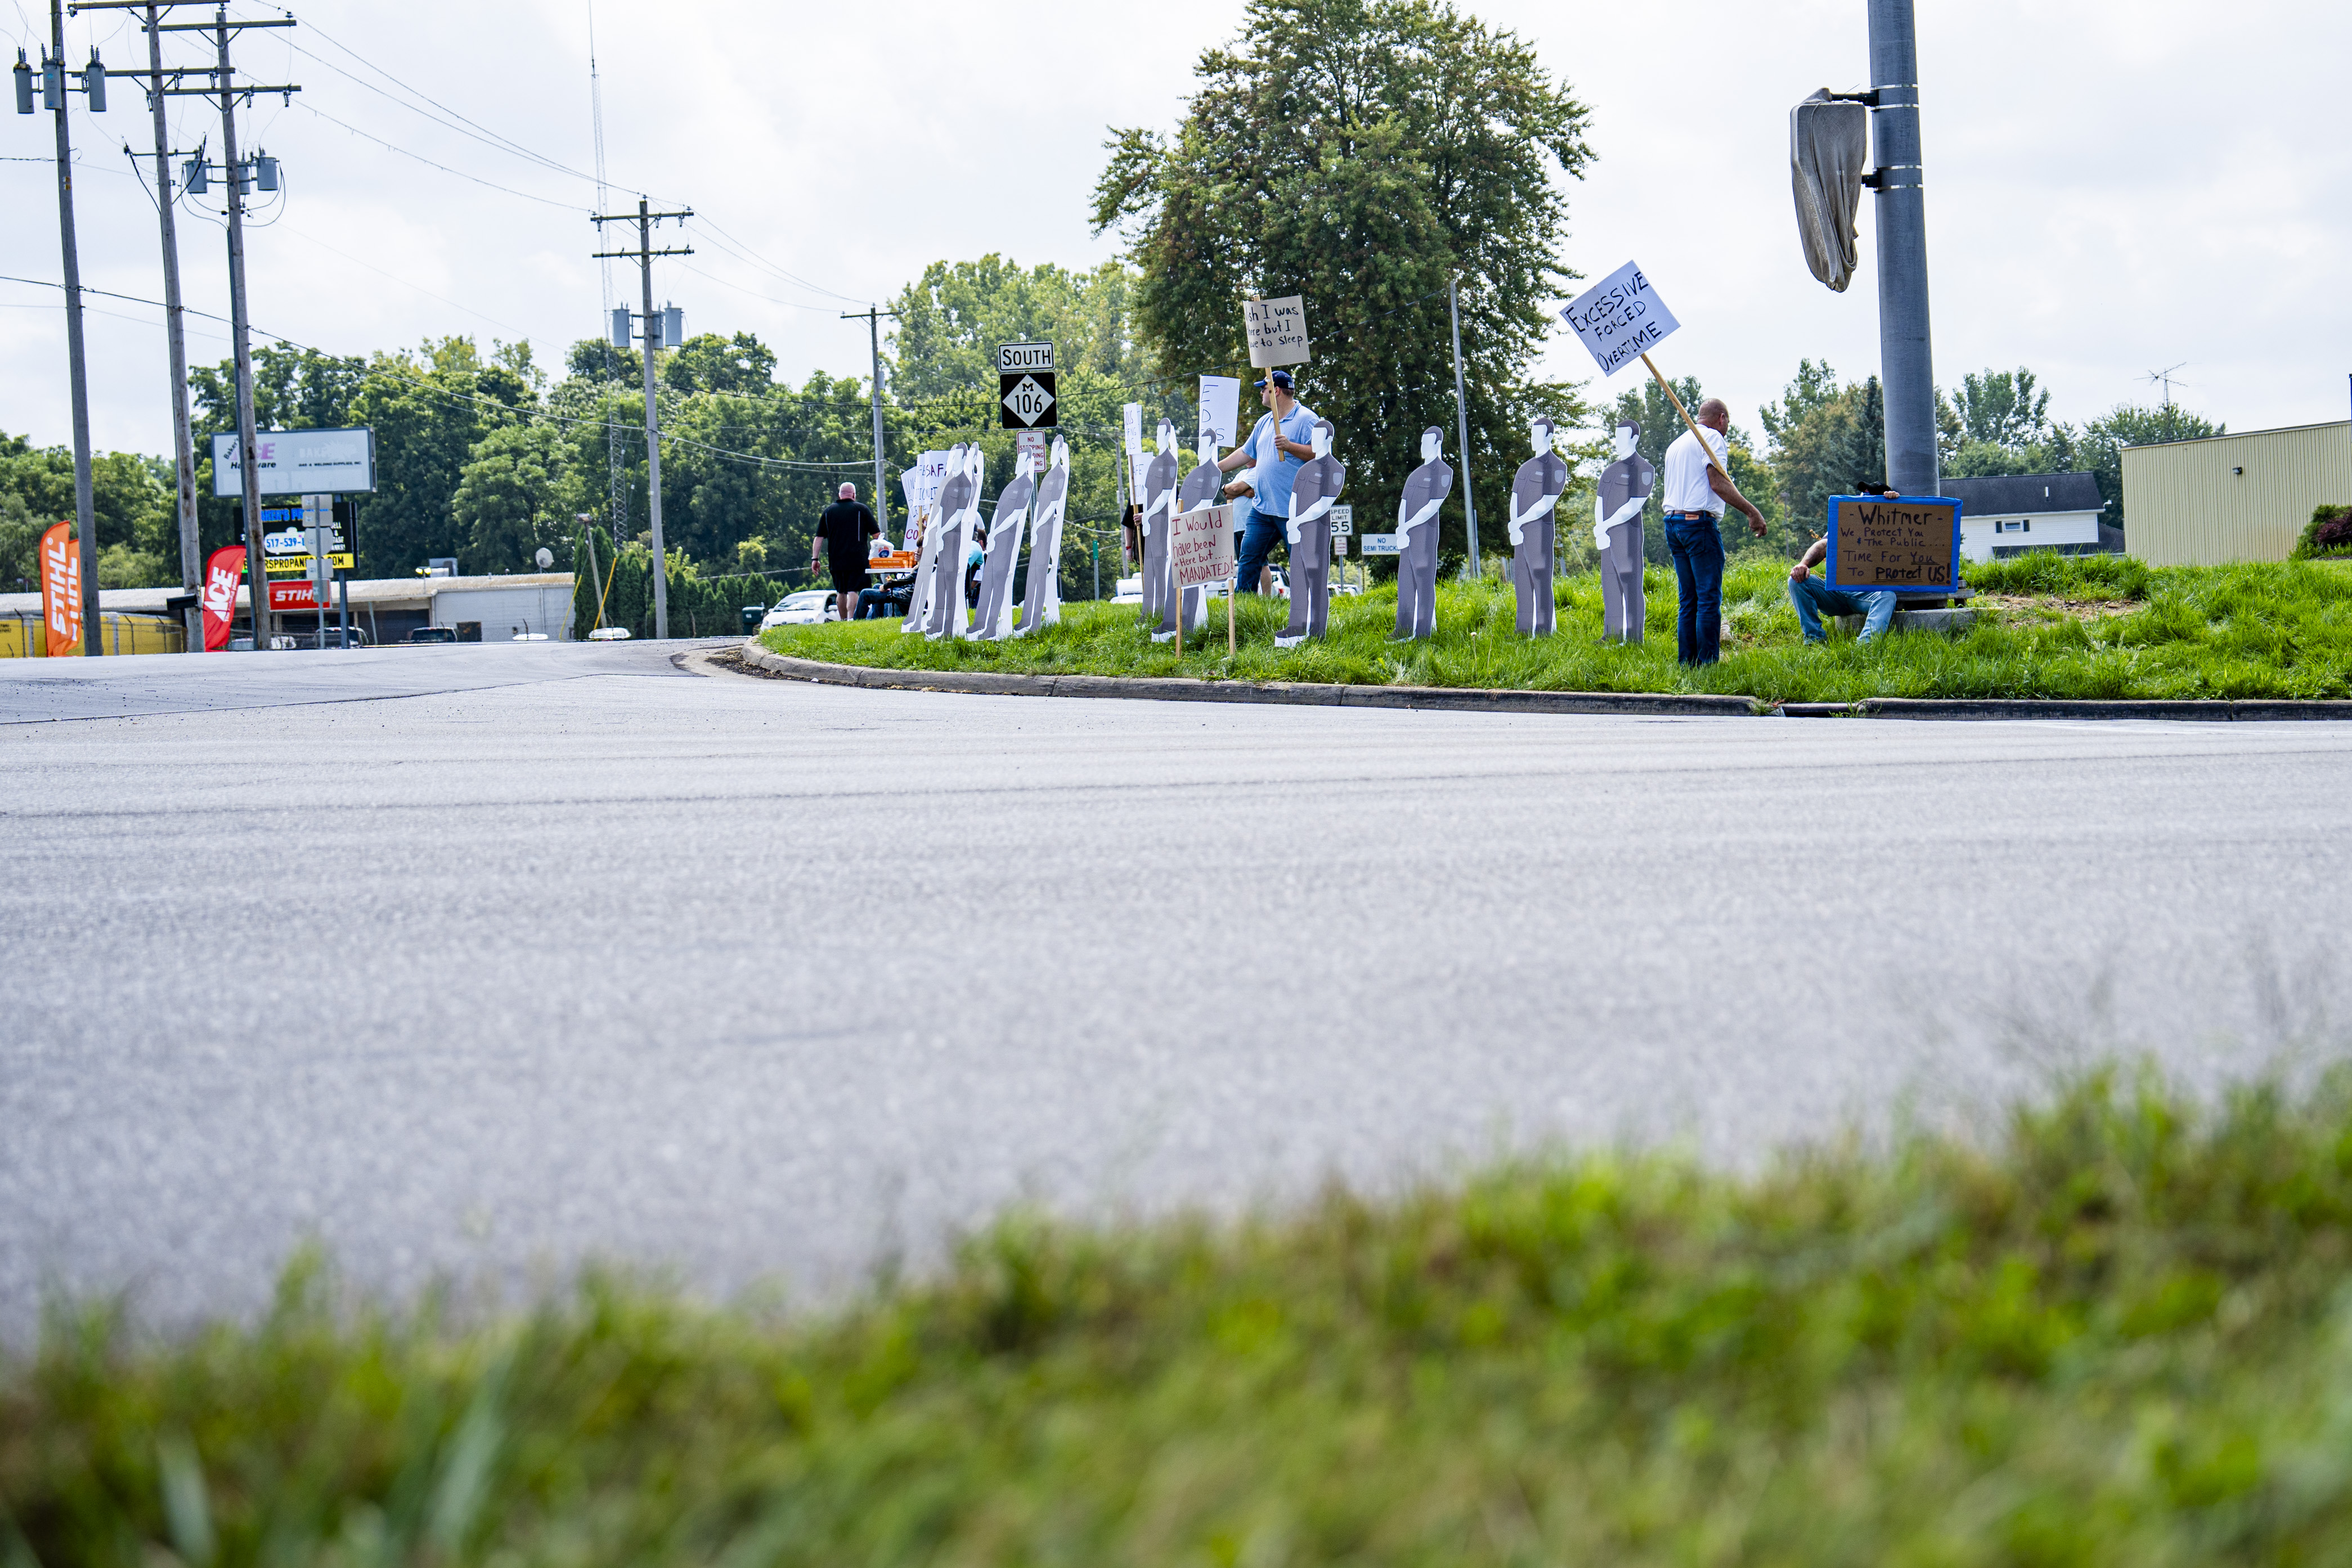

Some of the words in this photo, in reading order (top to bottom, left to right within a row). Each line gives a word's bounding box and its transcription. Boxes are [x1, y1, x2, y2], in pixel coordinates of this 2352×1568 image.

[1565, 271, 1649, 333] EXCESSIVE
[1261, 304, 1271, 319] I
[1274, 307, 1299, 316] was
[1264, 321, 1282, 334] but
[1285, 320, 1290, 331] I
[1594, 301, 1646, 342] FORCED
[1260, 338, 1273, 347] to
[1598, 321, 1662, 371] OVERTIME
[1002, 349, 1051, 366] SOUTH
[1022, 383, 1034, 392] M
[1015, 393, 1043, 414] 106
[261, 509, 290, 521] AKER'S
[1858, 505, 1932, 525] Whitmer
[1172, 519, 1181, 536] I
[1331, 522, 1349, 532] 55
[1841, 527, 1855, 537] We
[1908, 528, 1924, 537] You
[1173, 542, 1191, 559] have
[1881, 551, 1902, 562] For
[1910, 551, 1934, 563] You
[1179, 556, 1196, 567] Here
[1179, 555, 1233, 585] MANDATED!
[1847, 567, 1864, 576] To
[1928, 563, 1951, 584] US!
[48, 541, 67, 635] STIHL
[204, 567, 234, 622] ACE
[275, 589, 313, 601] STIH
